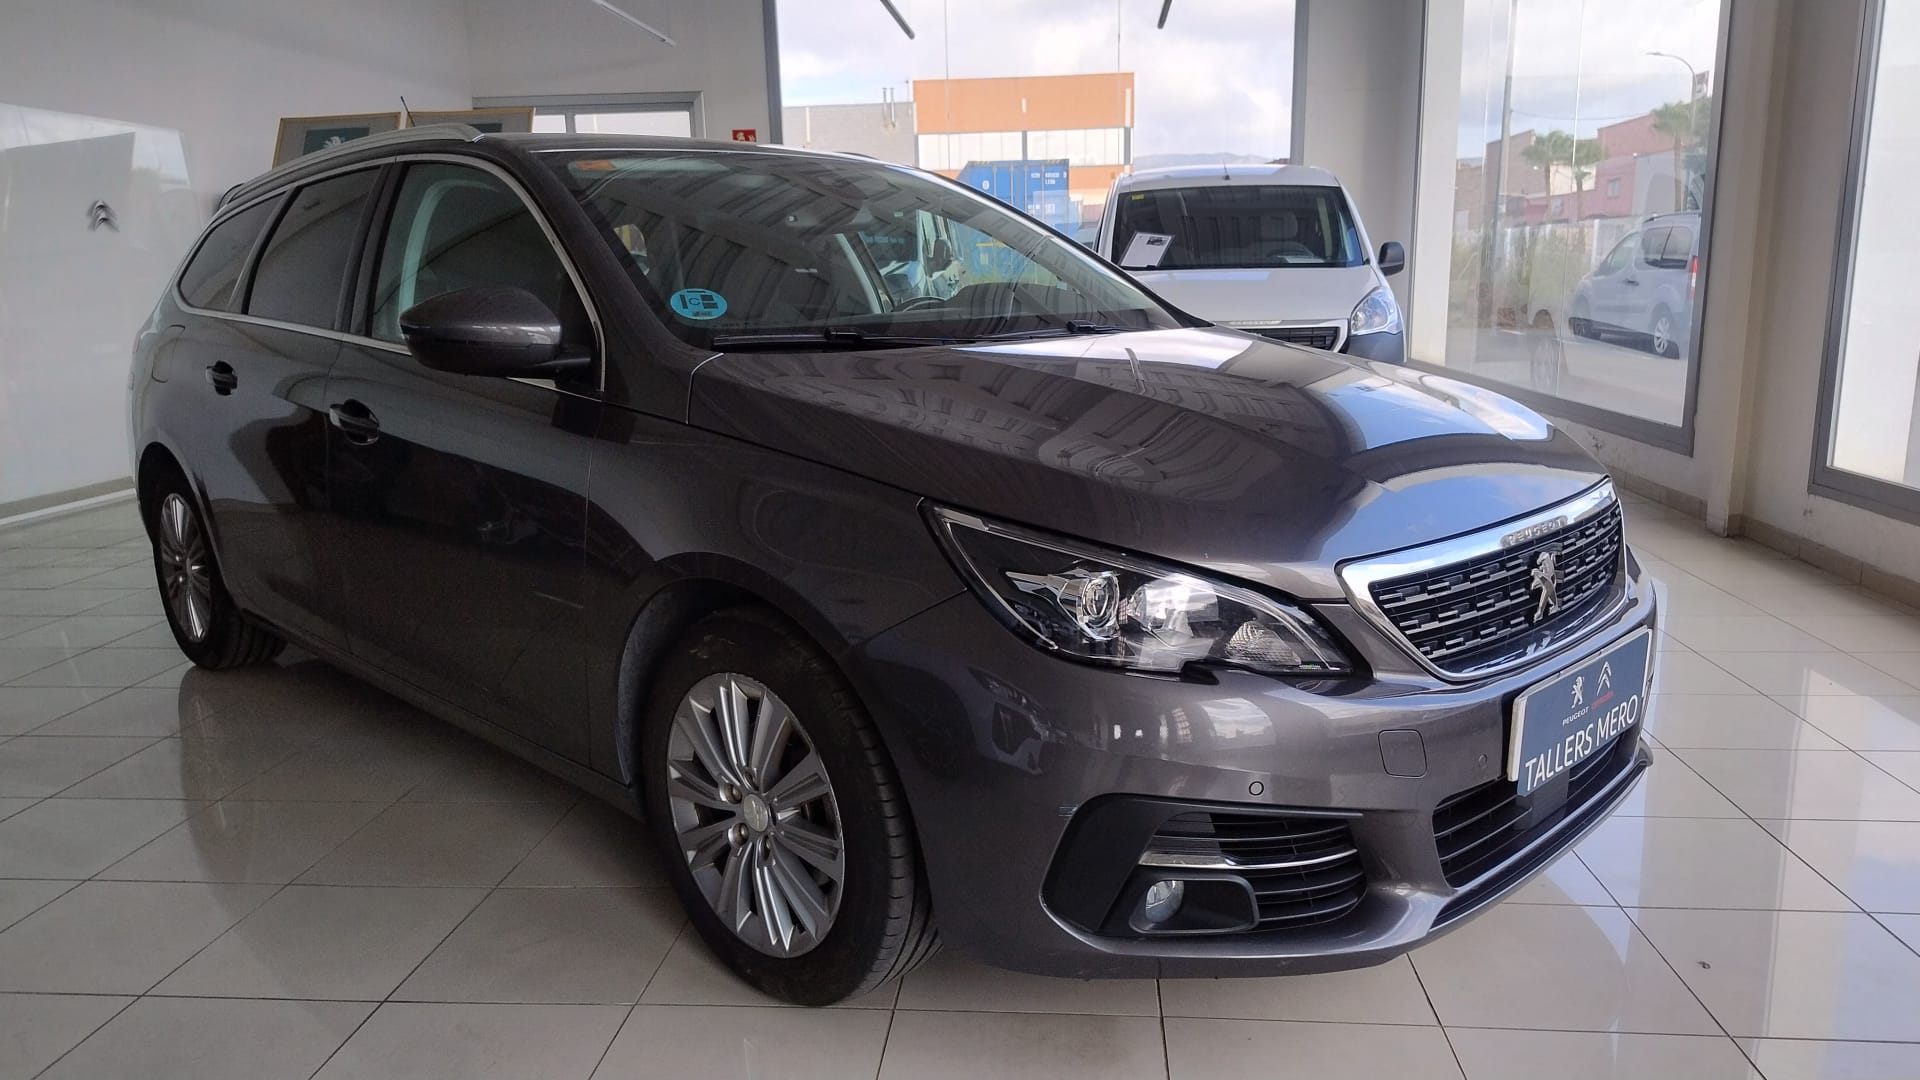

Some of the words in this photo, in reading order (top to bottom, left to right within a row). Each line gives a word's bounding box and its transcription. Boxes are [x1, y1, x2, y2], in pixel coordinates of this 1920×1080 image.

[1508, 518, 1563, 546] PEUGEOT
[1562, 705, 1590, 727] PEUGEOT
[1524, 722, 1594, 792] TALLERS
[1596, 694, 1638, 747] MERO
